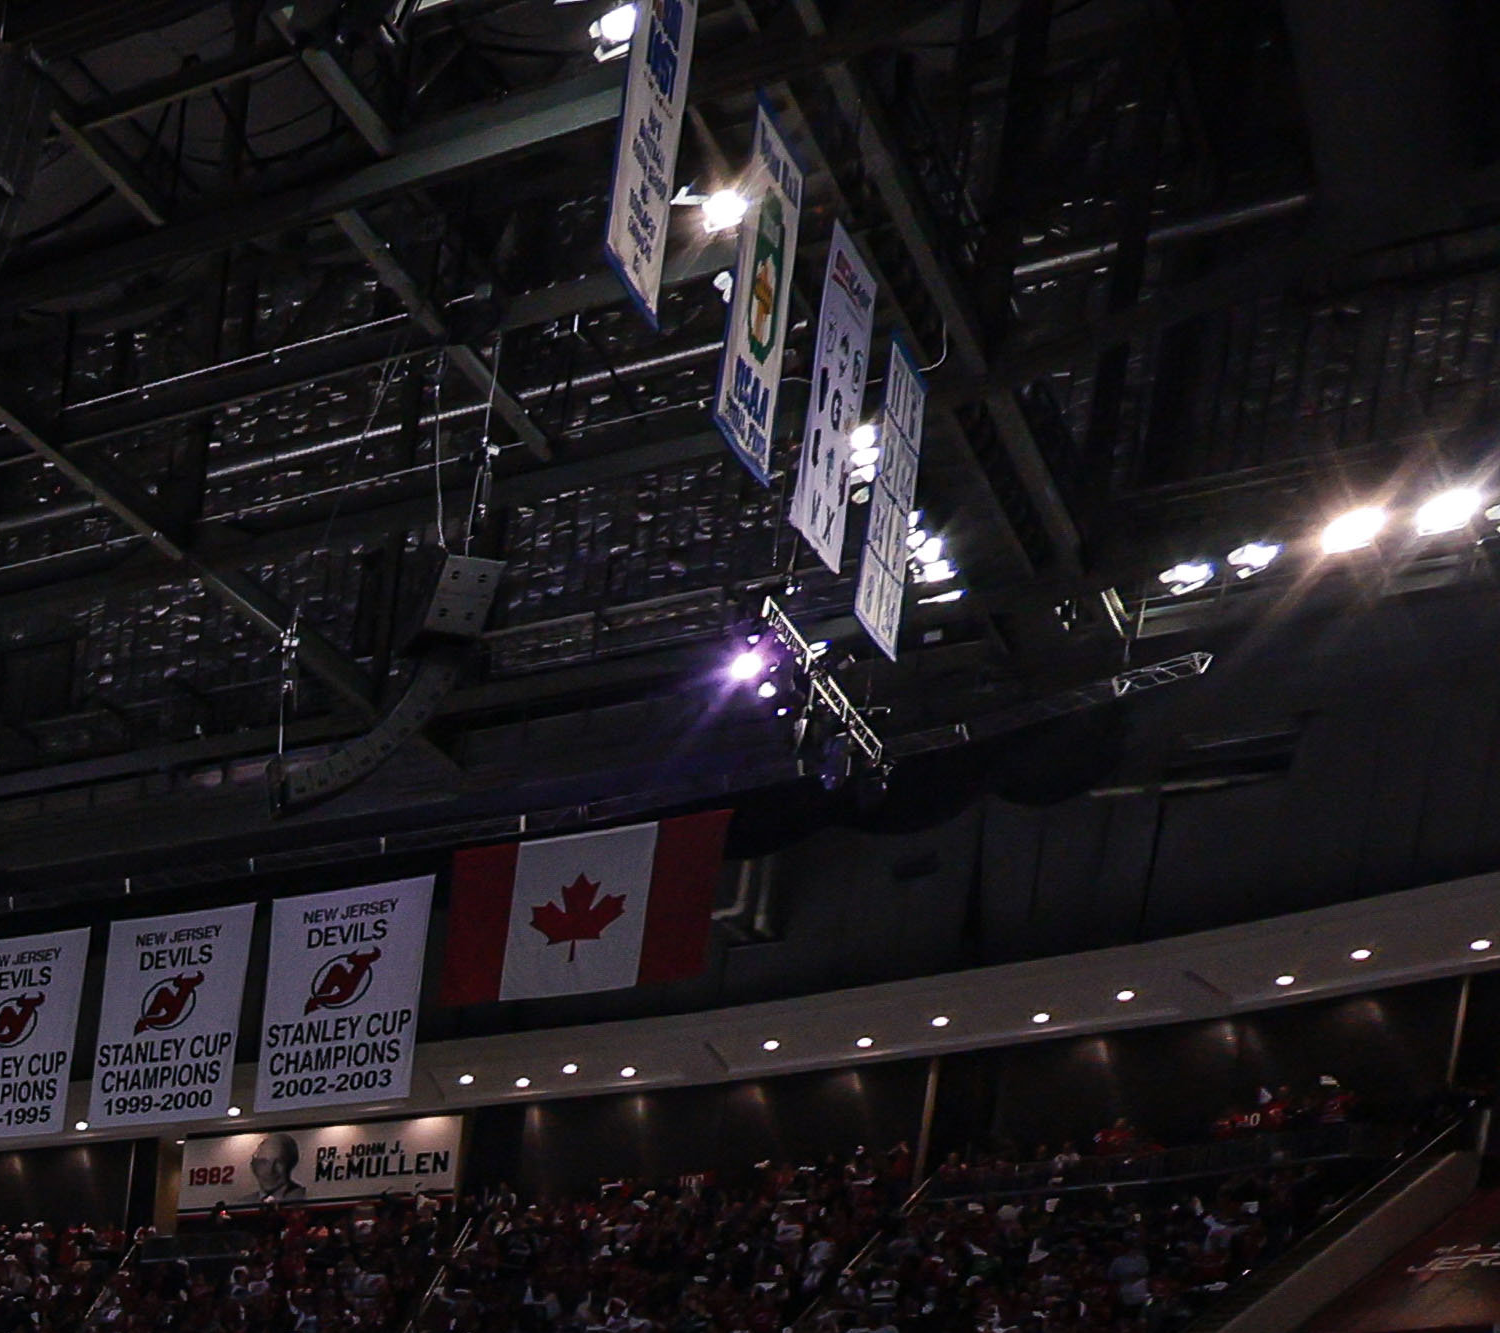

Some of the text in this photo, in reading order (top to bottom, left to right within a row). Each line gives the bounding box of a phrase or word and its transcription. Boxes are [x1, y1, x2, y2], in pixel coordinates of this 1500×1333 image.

[307, 919, 387, 949] DEVILS
[139, 944, 213, 971] DEVILS
[267, 1009, 412, 1048] STANLEY CUP
[28, 1052, 67, 1076] CUP
[98, 1033, 232, 1067] STANLEY CUP
[269, 1040, 400, 1076] CHAMPIONS
[101, 1061, 221, 1093] CHAMPIONS
[272, 1069, 392, 1099] 2002-2003
[104, 1090, 213, 1116] 1999-2000
[317, 1141, 386, 1160] DR. JOHN
[189, 1165, 234, 1186] 1982
[315, 1151, 448, 1181] McMULLEN
